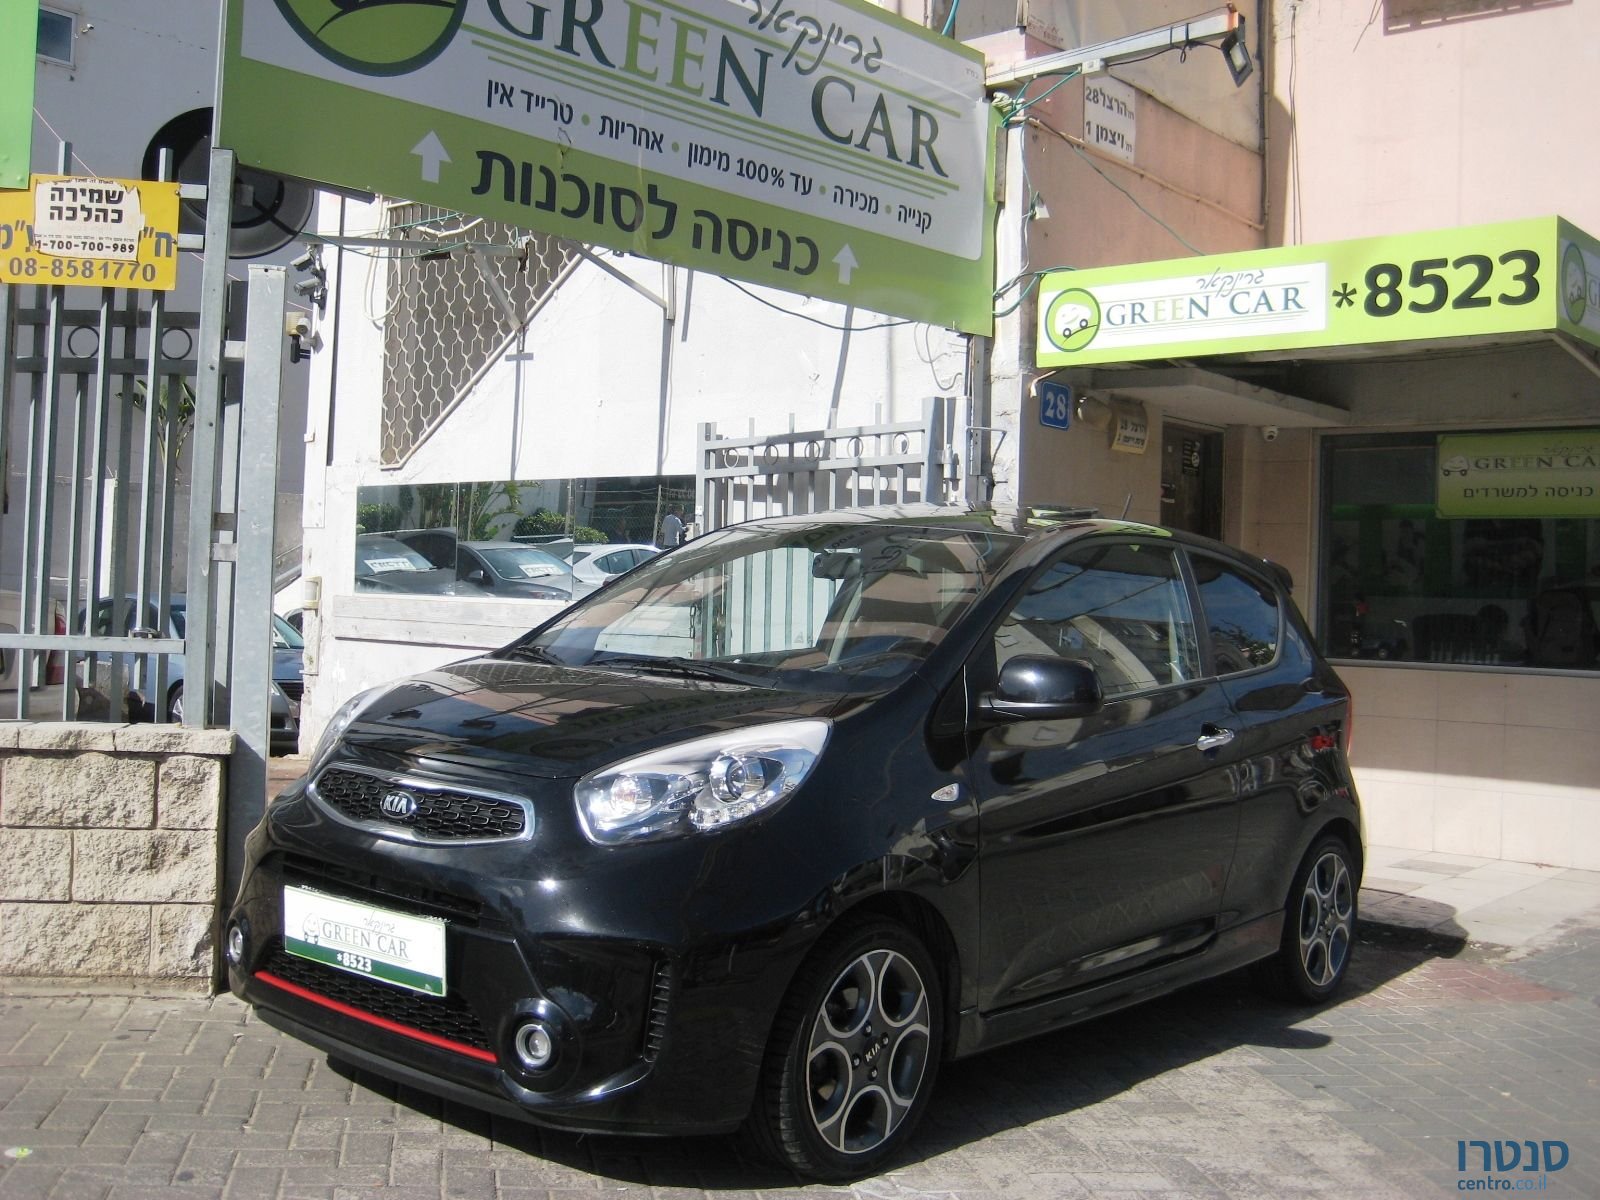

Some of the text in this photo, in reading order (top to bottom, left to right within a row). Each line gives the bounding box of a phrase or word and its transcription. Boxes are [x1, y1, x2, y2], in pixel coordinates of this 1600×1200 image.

[811, 75, 949, 178] CAR
[1085, 120, 1092, 136] 1
[1095, 123, 1125, 150] ויצמן
[487, 79, 932, 235] קנייה מכירה עד 100% מימון אחריות טרייד אין
[50, 187, 124, 205] שמירה
[49, 204, 124, 224] כהלכה
[470, 149, 820, 276] כניסה לסוכנות
[34, 239, 136, 253] 1-700-700-989
[9, 257, 156, 282] 08-8581770
[1105, 286, 1306, 327] GREEN CAR
[1045, 391, 1067, 420] 28
[1474, 455, 1600, 470] GREEN CA
[1463, 484, 1594, 498] כניסה למשרדים
[383, 794, 407, 814] KIA
[322, 921, 409, 959] GREEN CAR
[864, 1042, 880, 1062] KIA
